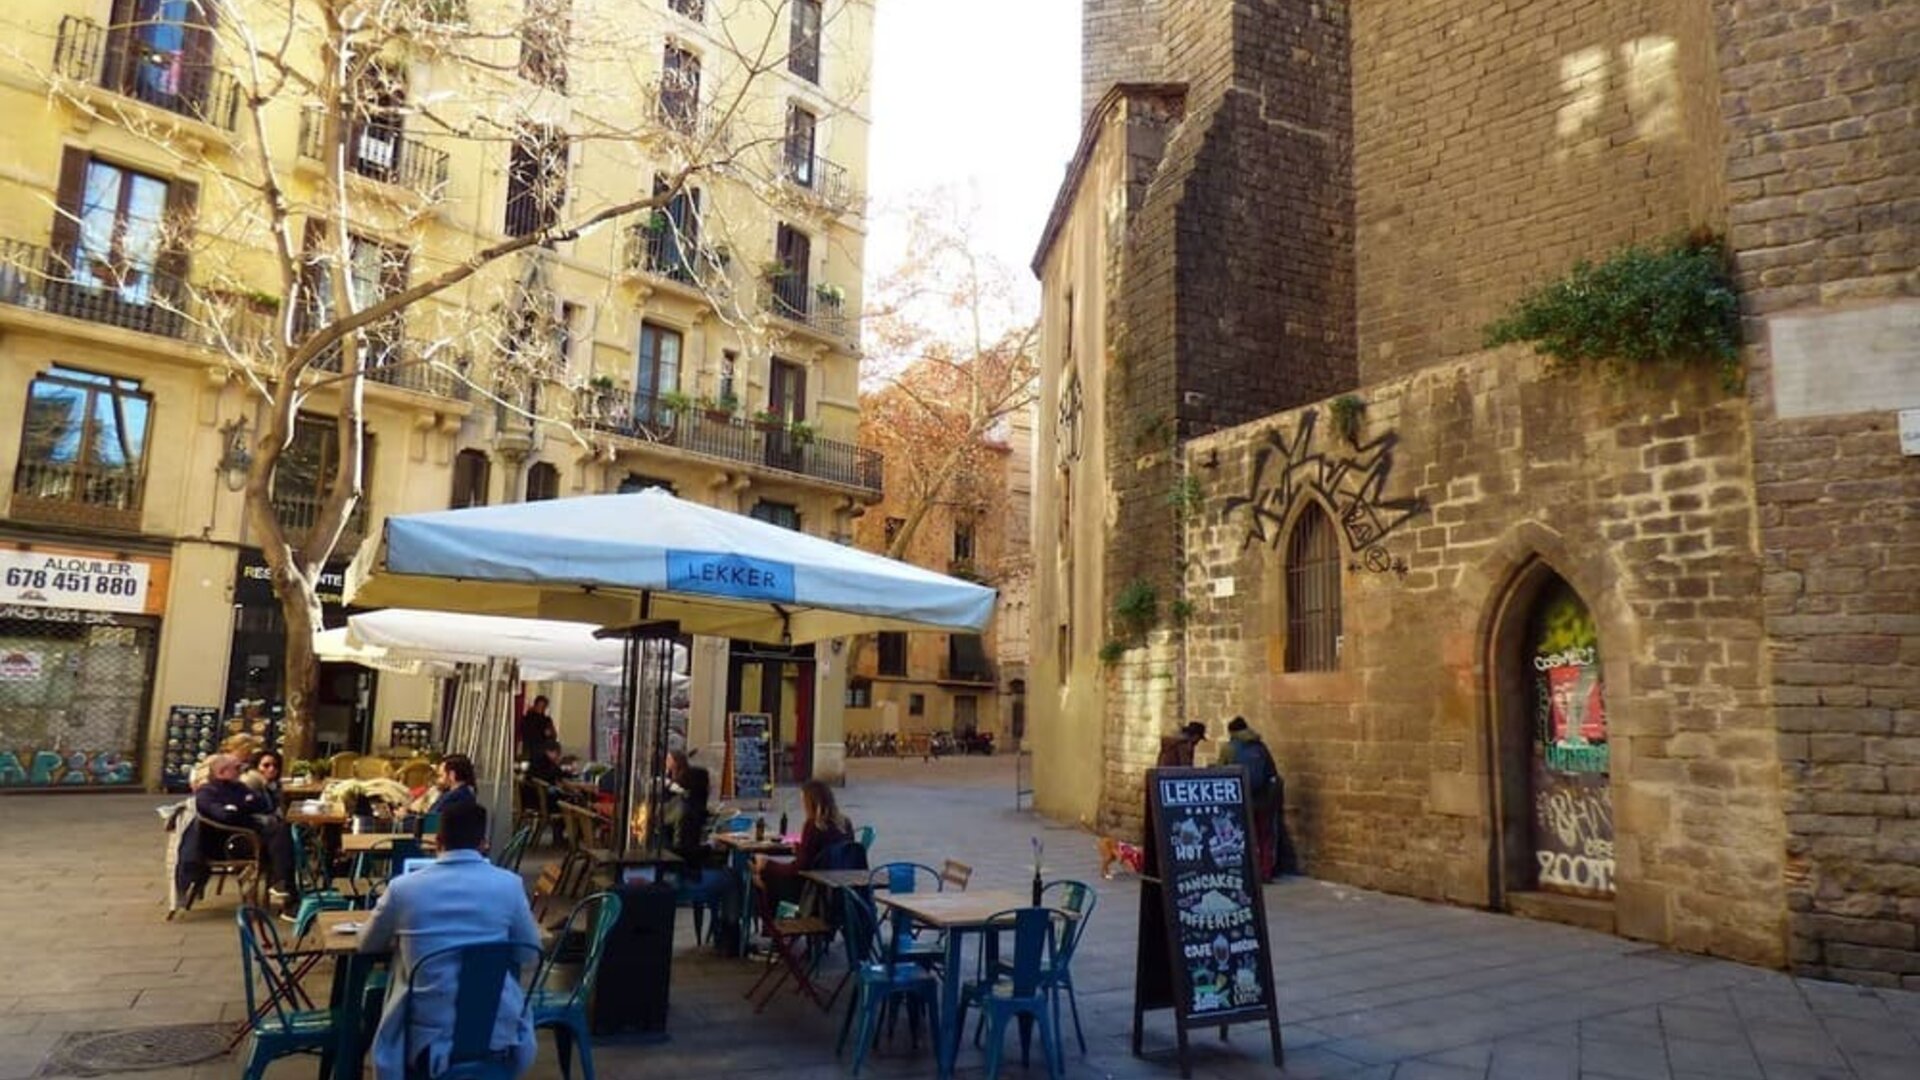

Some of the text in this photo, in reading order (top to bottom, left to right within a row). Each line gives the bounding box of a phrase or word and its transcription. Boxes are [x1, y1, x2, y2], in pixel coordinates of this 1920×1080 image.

[44, 558, 131, 576] ALQUILER
[688, 562, 777, 588] LEKKER
[6, 567, 137, 597] 678 451 880
[1165, 782, 1237, 802] LEKKER
[1175, 845, 1204, 861] HOT
[1177, 874, 1243, 893] PANCAKES
